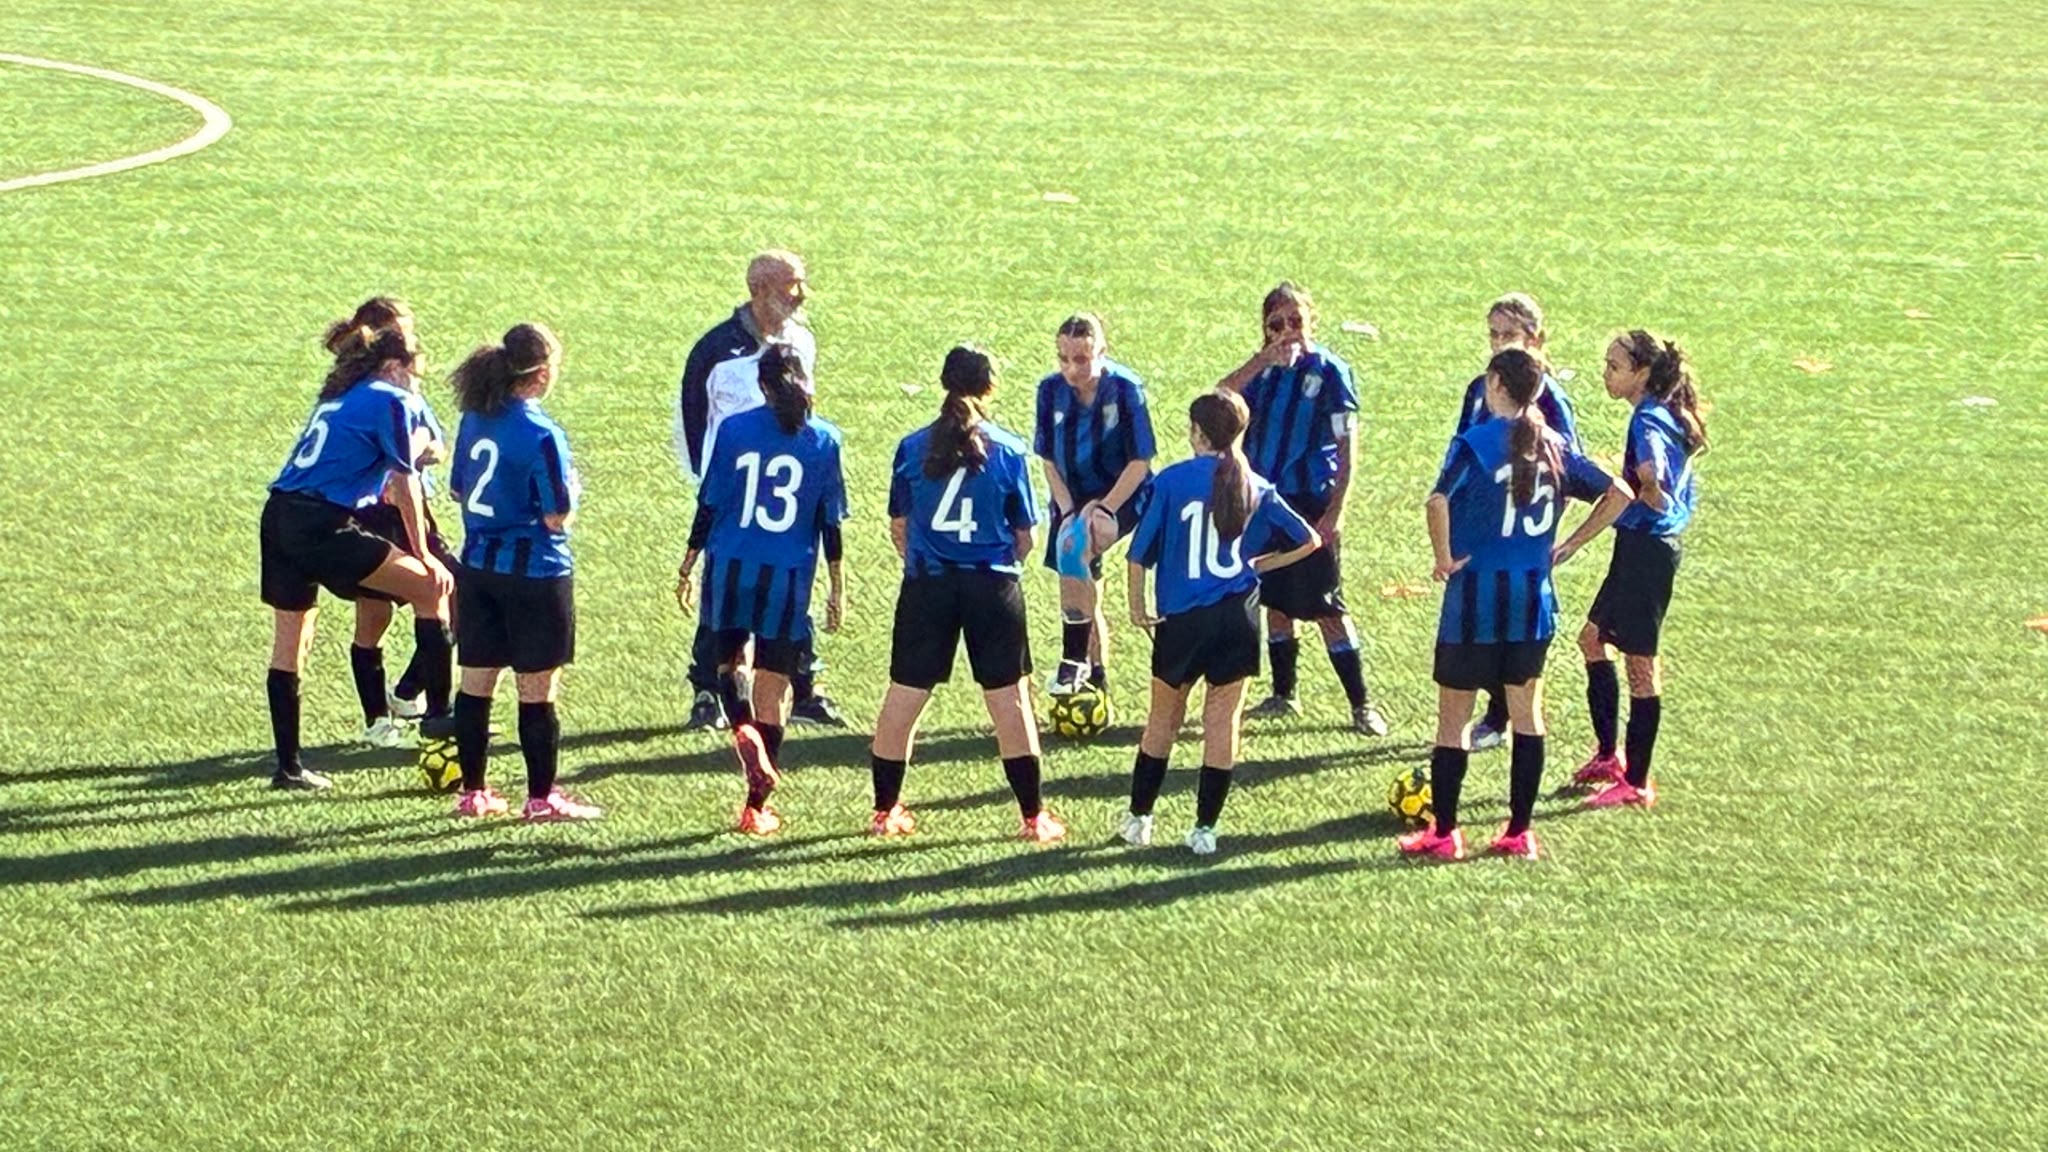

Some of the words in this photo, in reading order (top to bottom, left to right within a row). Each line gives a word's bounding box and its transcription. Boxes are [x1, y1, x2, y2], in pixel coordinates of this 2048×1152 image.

[293, 400, 345, 469] 5
[467, 437, 499, 517] 2
[735, 451, 804, 533] 13
[931, 467, 978, 542] 4
[1495, 461, 1555, 537] 15
